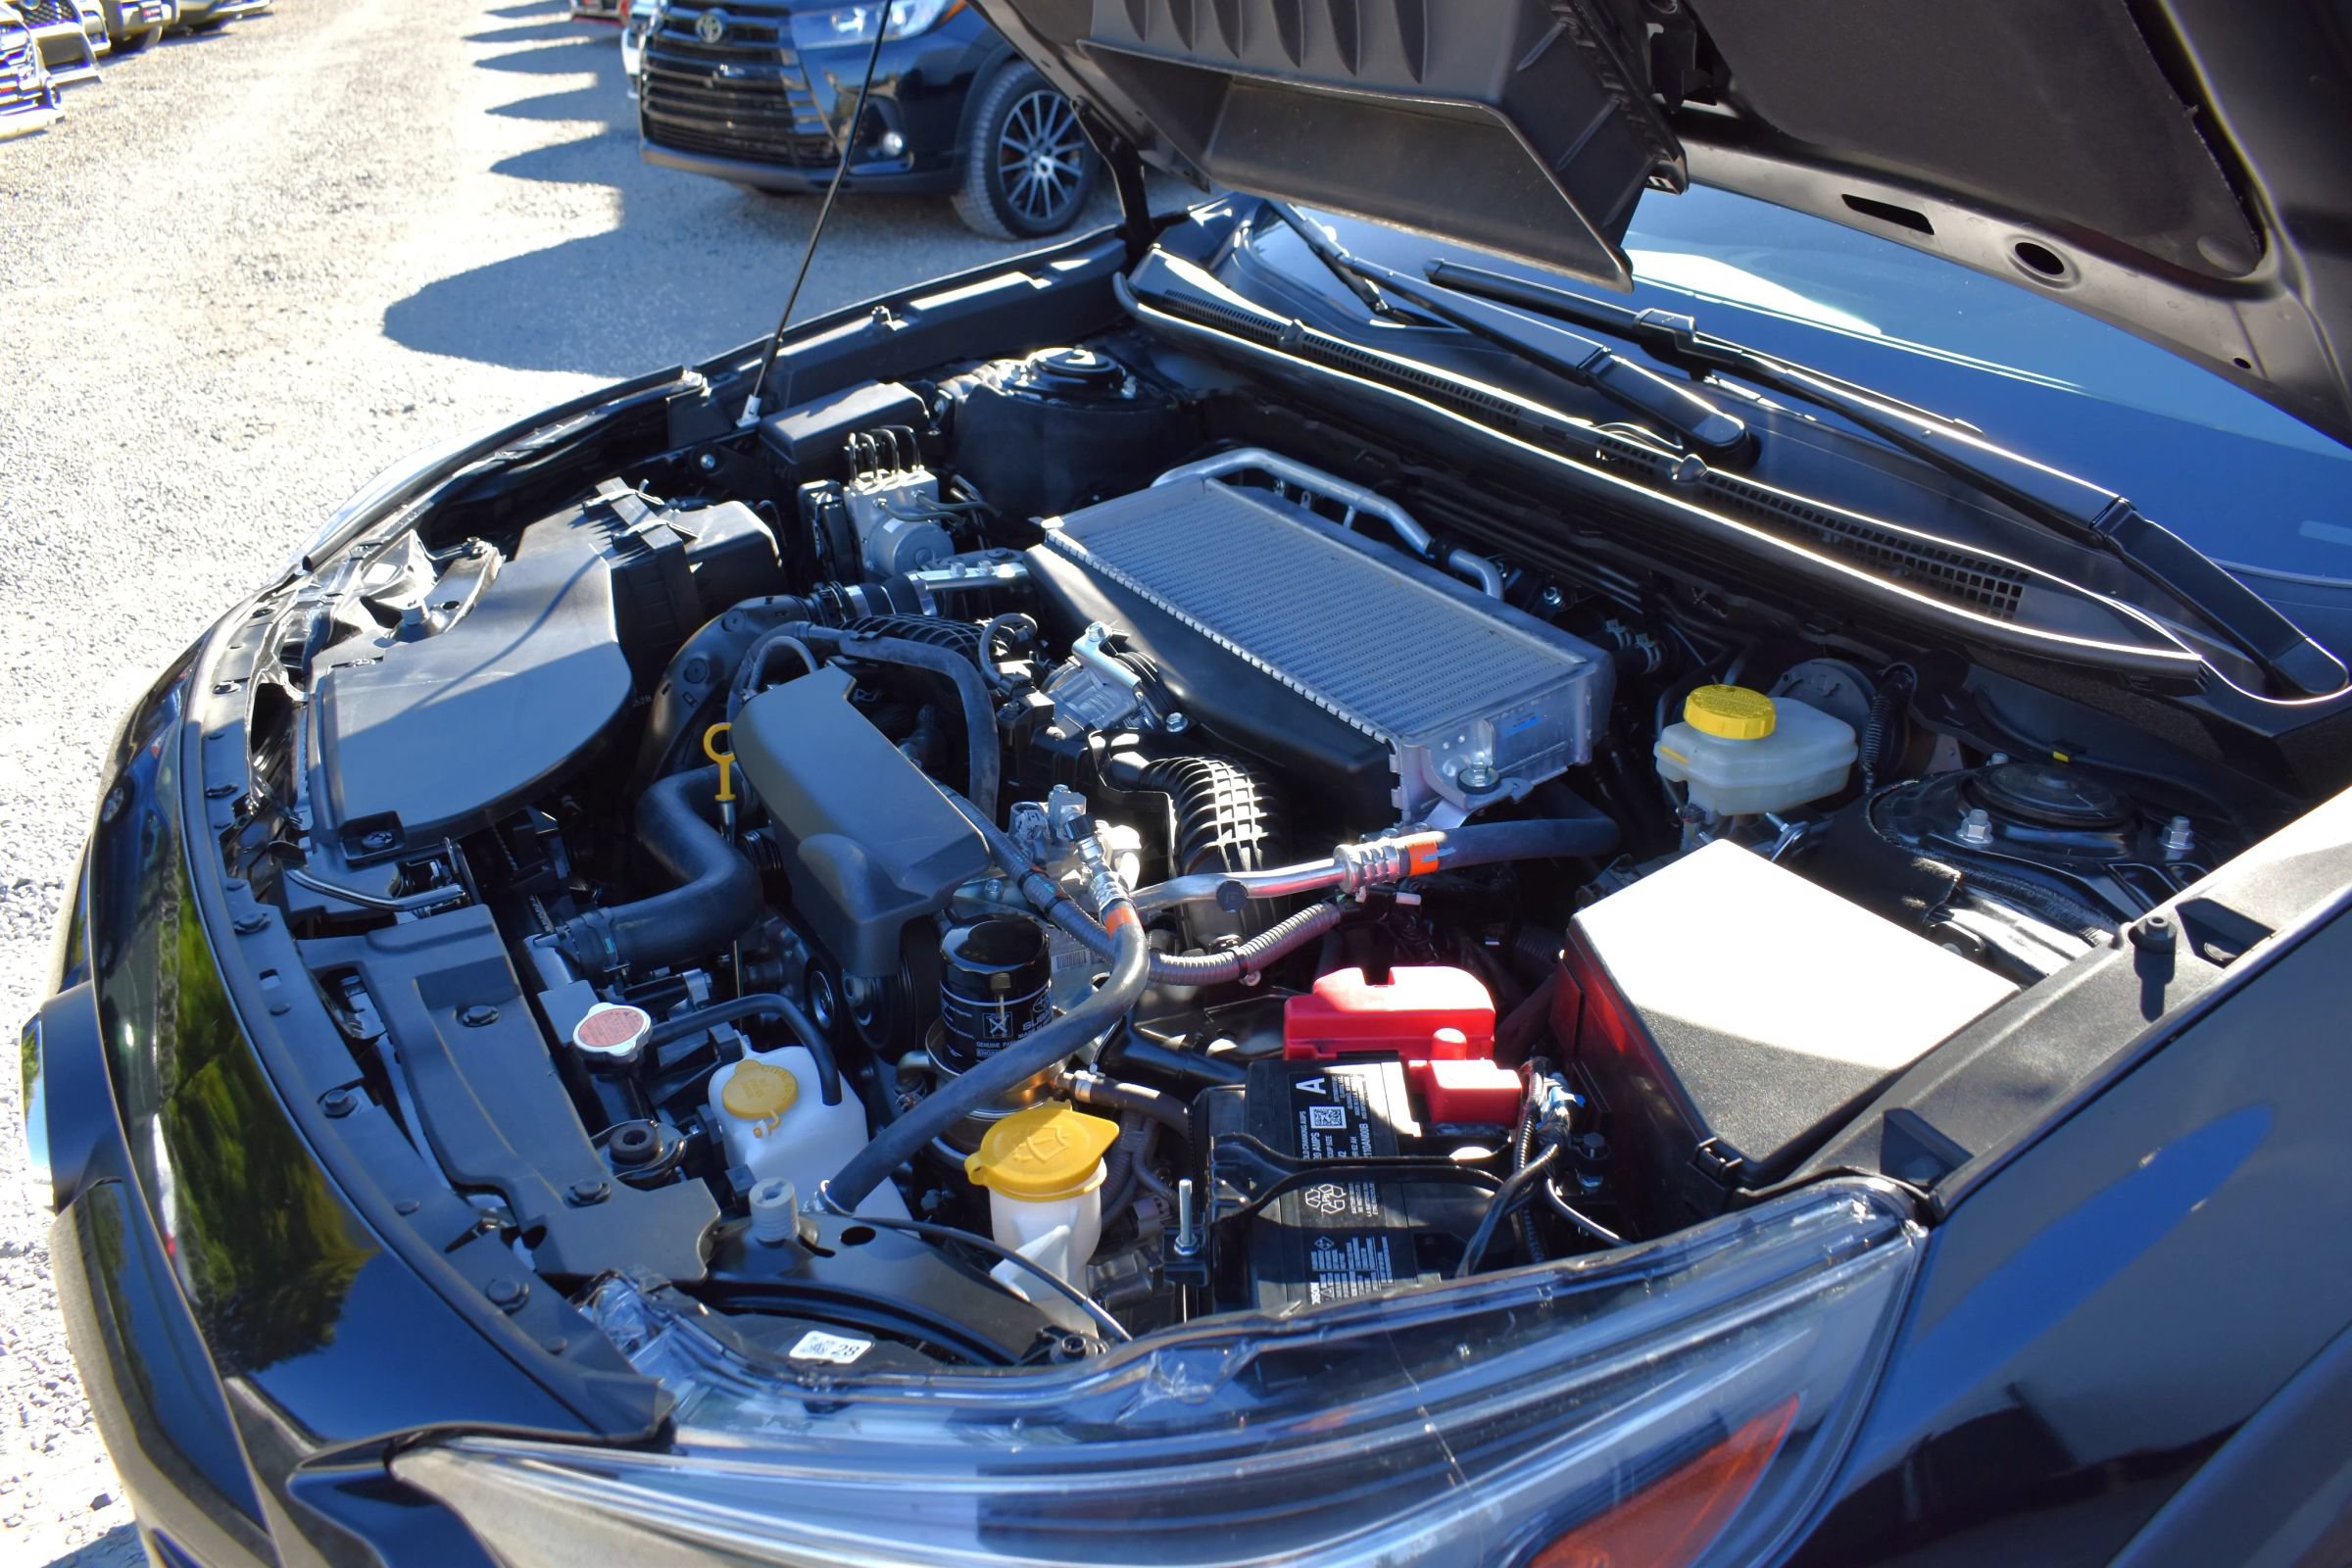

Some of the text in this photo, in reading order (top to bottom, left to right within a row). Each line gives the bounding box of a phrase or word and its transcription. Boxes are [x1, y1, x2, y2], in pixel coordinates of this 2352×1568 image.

[1296, 1078, 1326, 1095] A
[1310, 1132, 1322, 1152] AMPS
[831, 1344, 859, 1356] 28
